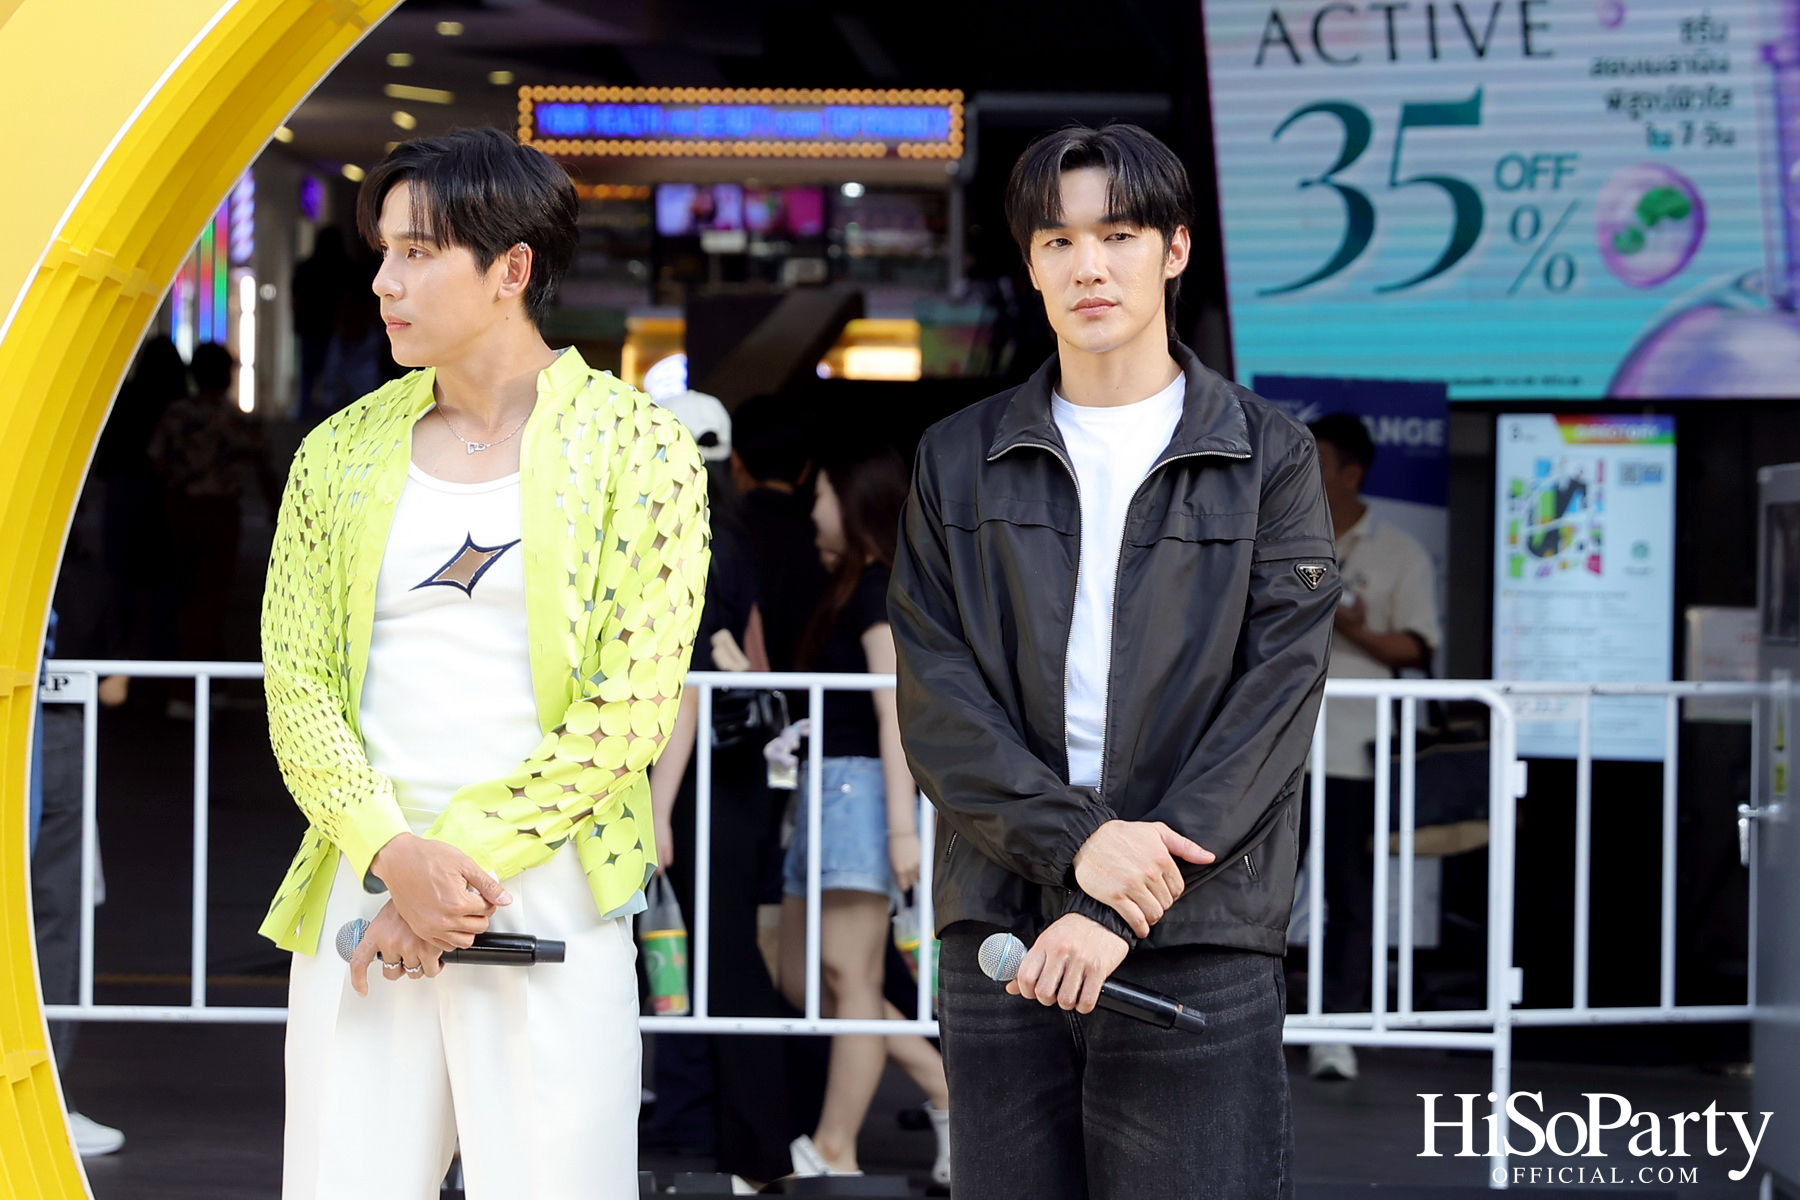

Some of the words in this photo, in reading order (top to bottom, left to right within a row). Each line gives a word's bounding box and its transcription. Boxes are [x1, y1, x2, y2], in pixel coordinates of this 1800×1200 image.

[1254, 0, 1555, 66] ACTIVE
[1256, 86, 1484, 297] 35
[1494, 152, 1580, 192] OFF
[1507, 198, 1581, 296] %
